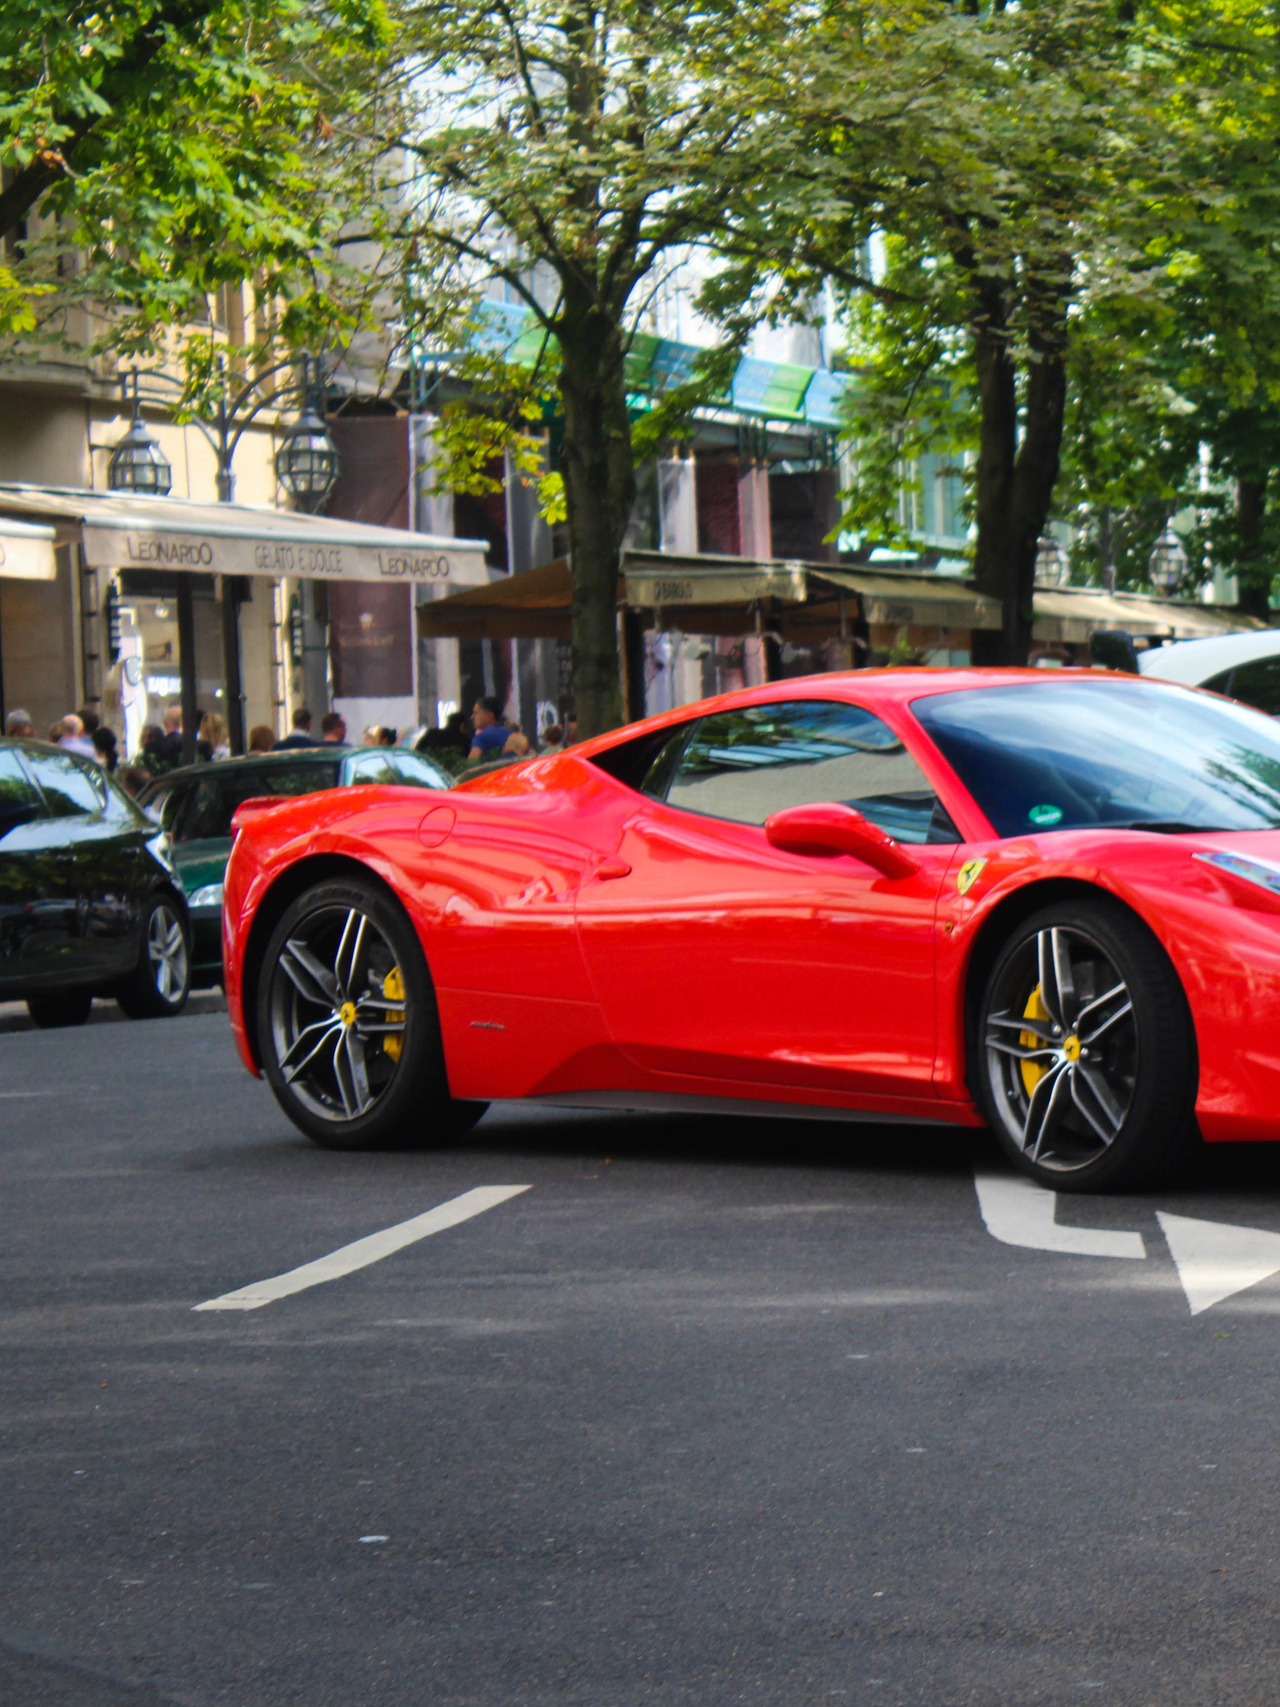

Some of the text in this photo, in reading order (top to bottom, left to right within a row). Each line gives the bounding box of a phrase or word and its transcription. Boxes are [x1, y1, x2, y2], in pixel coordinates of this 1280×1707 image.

[126, 536, 213, 565] LEONARDO
[255, 545, 343, 573] GELATO E DOLCE
[377, 552, 450, 577] LEONARDO
